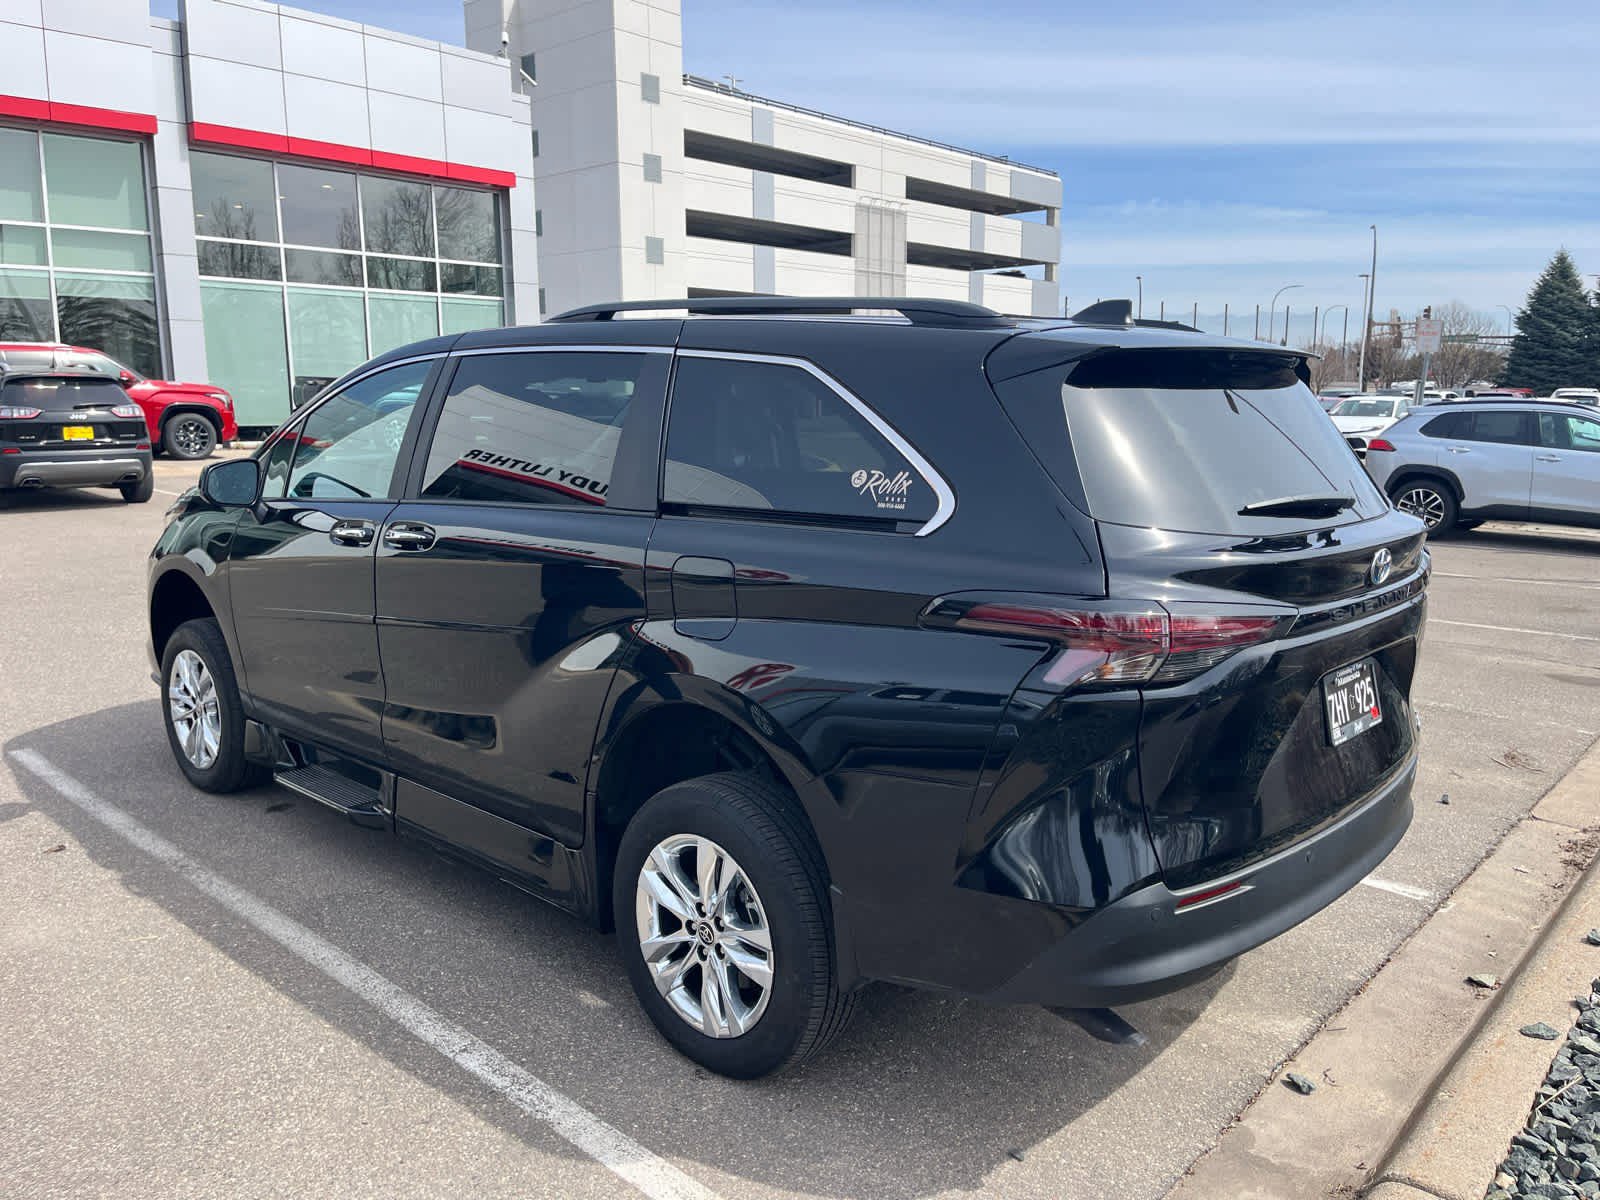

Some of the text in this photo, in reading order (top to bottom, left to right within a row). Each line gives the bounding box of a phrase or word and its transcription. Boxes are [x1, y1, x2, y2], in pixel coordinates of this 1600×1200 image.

[859, 470, 912, 502] Rollx
[1328, 677, 1375, 727] ZHY 925
